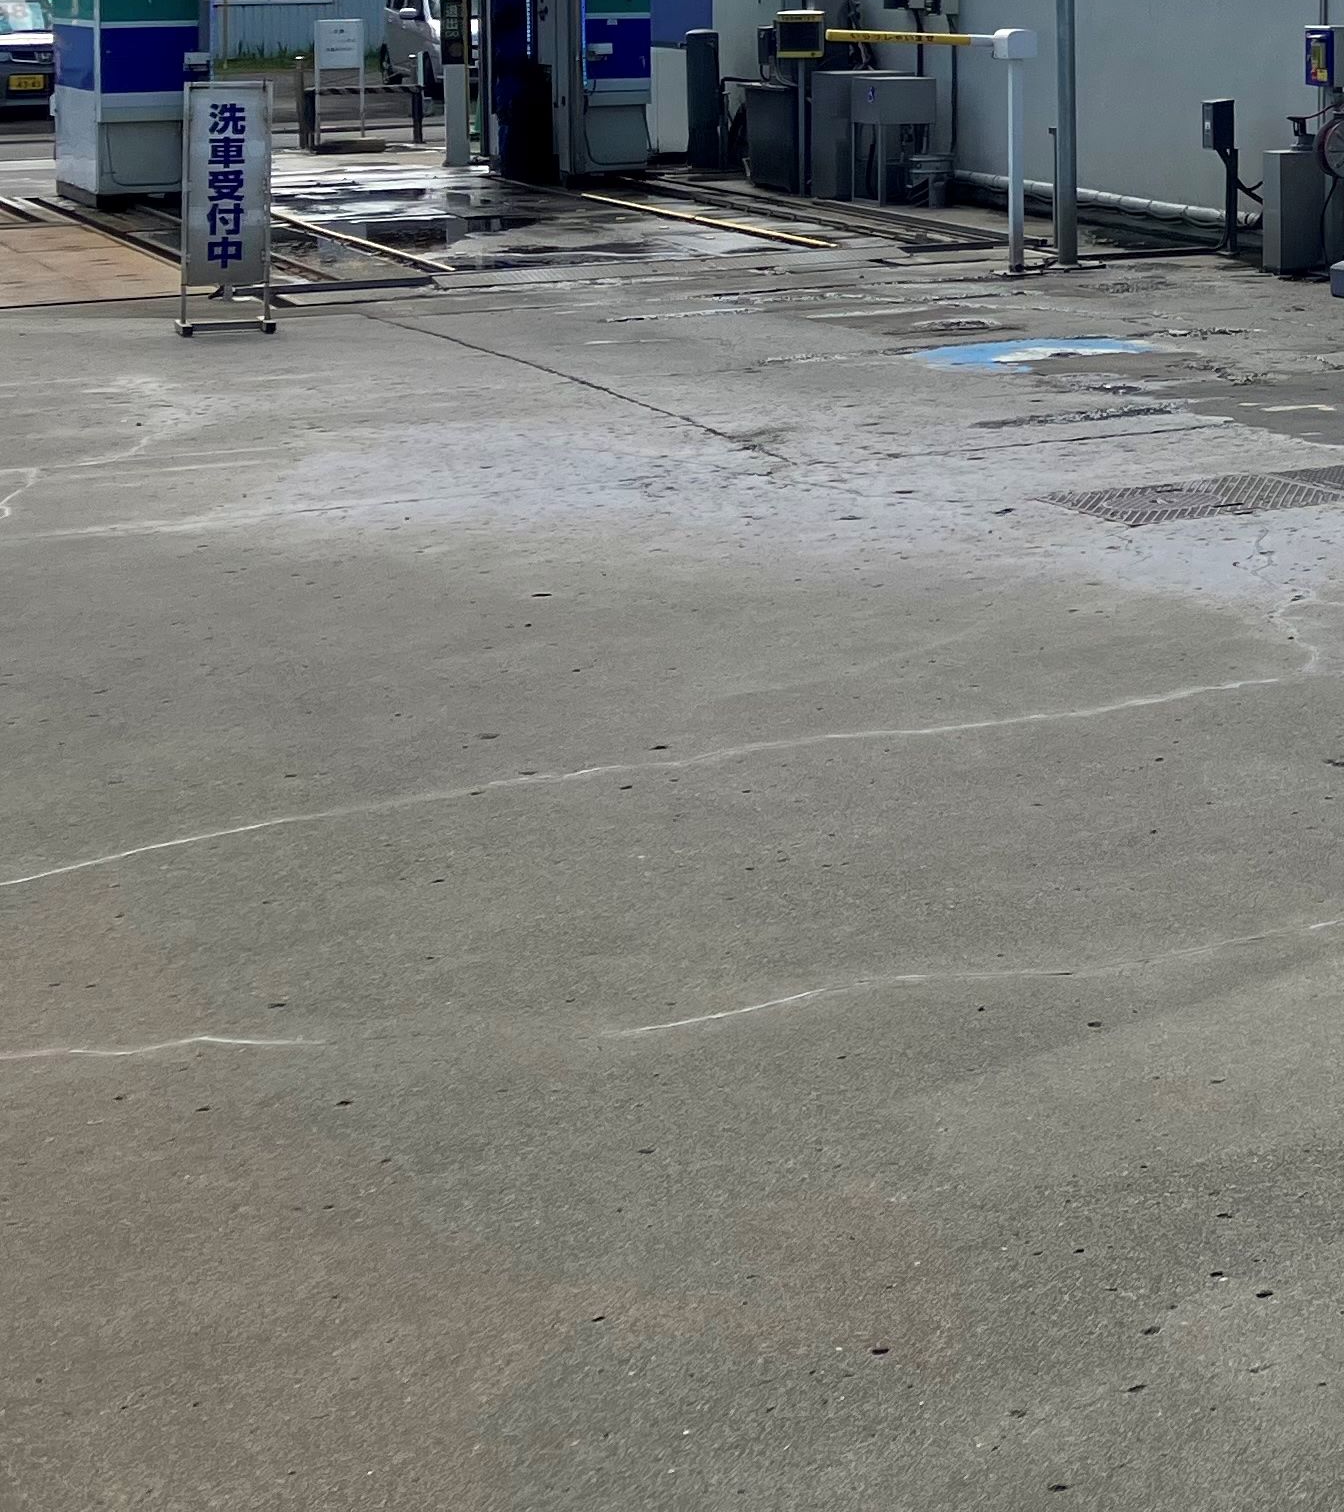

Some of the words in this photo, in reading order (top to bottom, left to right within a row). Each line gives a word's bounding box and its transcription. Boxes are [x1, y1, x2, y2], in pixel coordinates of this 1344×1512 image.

[207, 104, 245, 269] 洗車受付中
